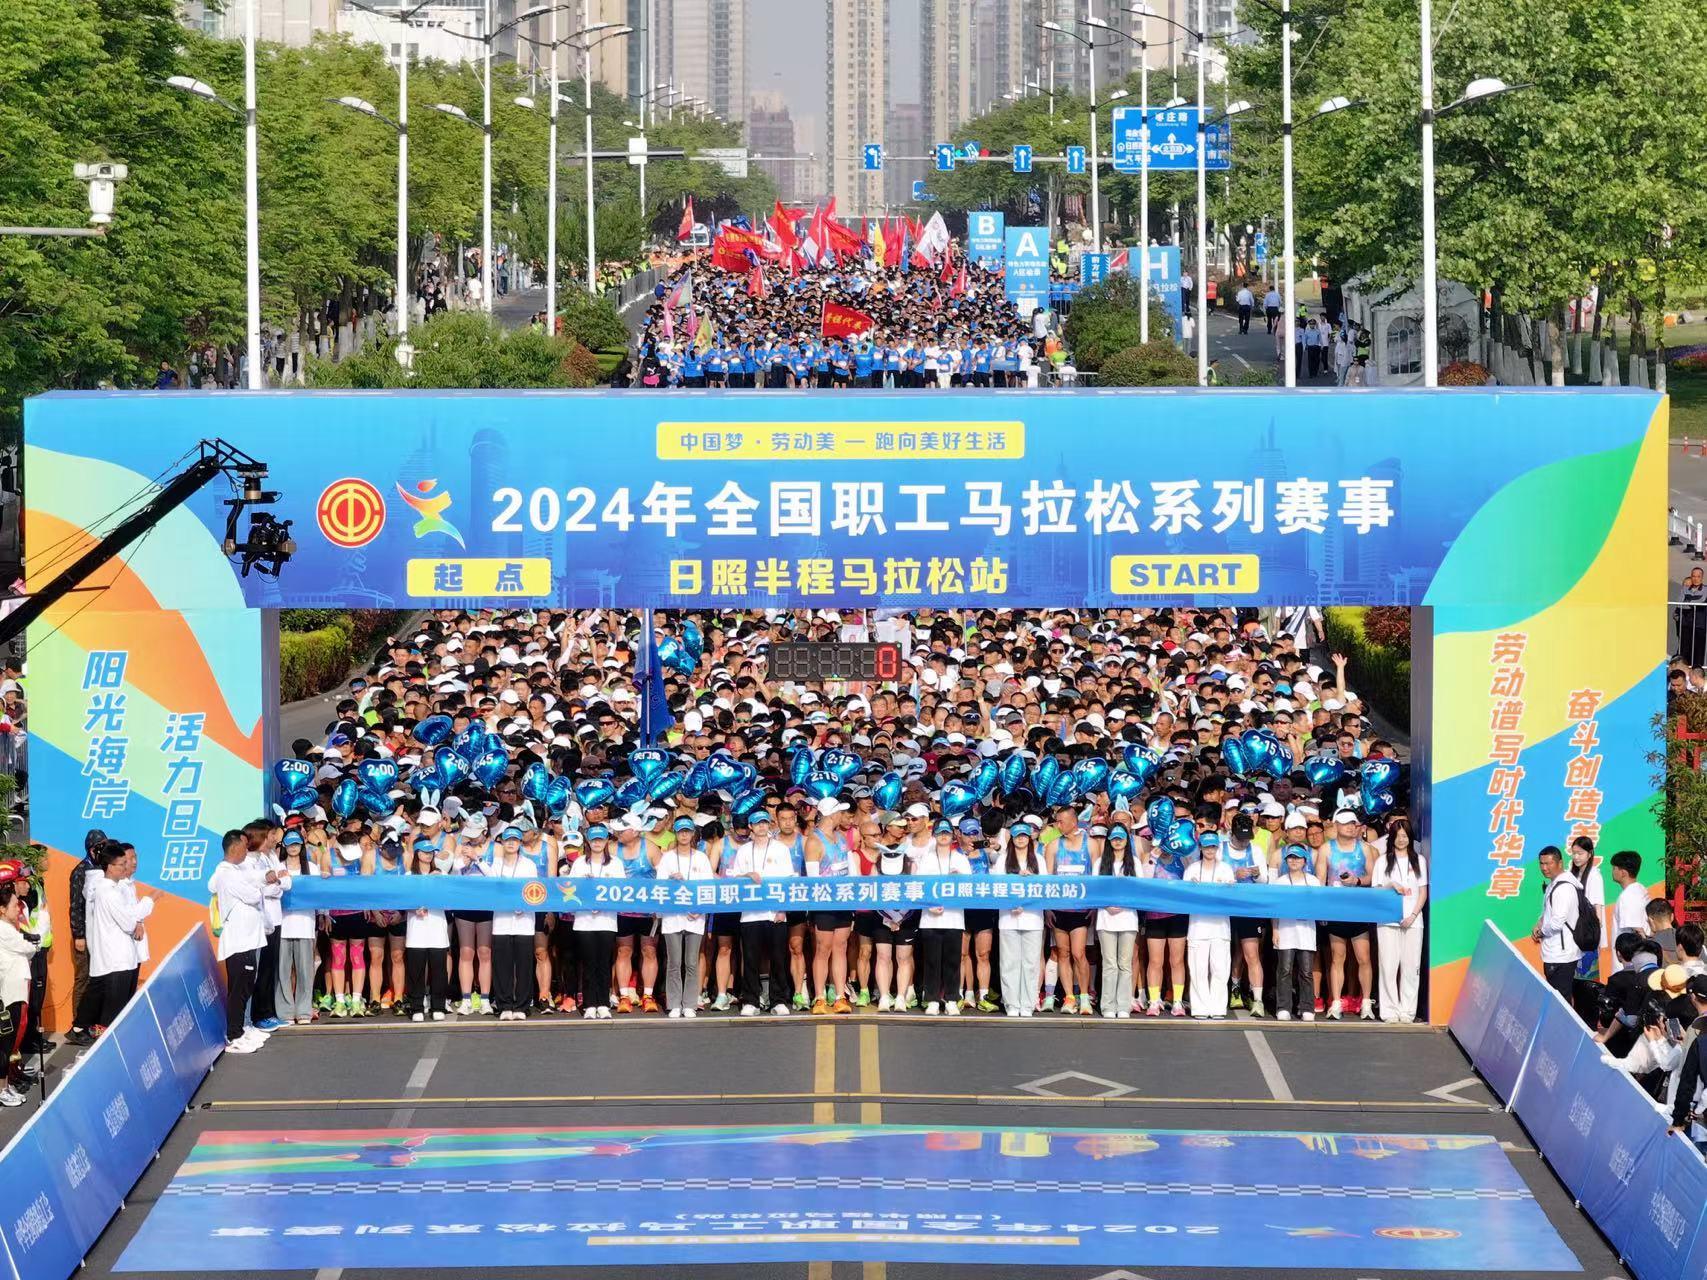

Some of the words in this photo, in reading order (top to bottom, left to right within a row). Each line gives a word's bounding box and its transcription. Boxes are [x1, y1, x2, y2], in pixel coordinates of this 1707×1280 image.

[978, 216, 995, 235] B
[1015, 232, 1040, 257] A
[1142, 251, 1169, 280] H
[492, 476, 1395, 537] 2024年全国职工马拉松系列赛事
[433, 562, 525, 593] 起点
[670, 557, 1009, 596] 日照半程马拉松站
[1129, 562, 1243, 587] START
[81, 651, 129, 819] 阳光海岸
[282, 761, 310, 775] 2:00
[446, 752, 470, 775] 2:00
[827, 753, 854, 769] 2:15
[1133, 746, 1158, 765] 1:45
[1487, 631, 1528, 900] 劳动谱写时代华章
[366, 763, 395, 777] 2:00
[416, 766, 436, 781] 2:0
[810, 771, 839, 783] 2:15
[1366, 763, 1390, 775] 2:30
[1564, 688, 1603, 870] 奋斗创造美
[159, 712, 209, 881] 活力日照
